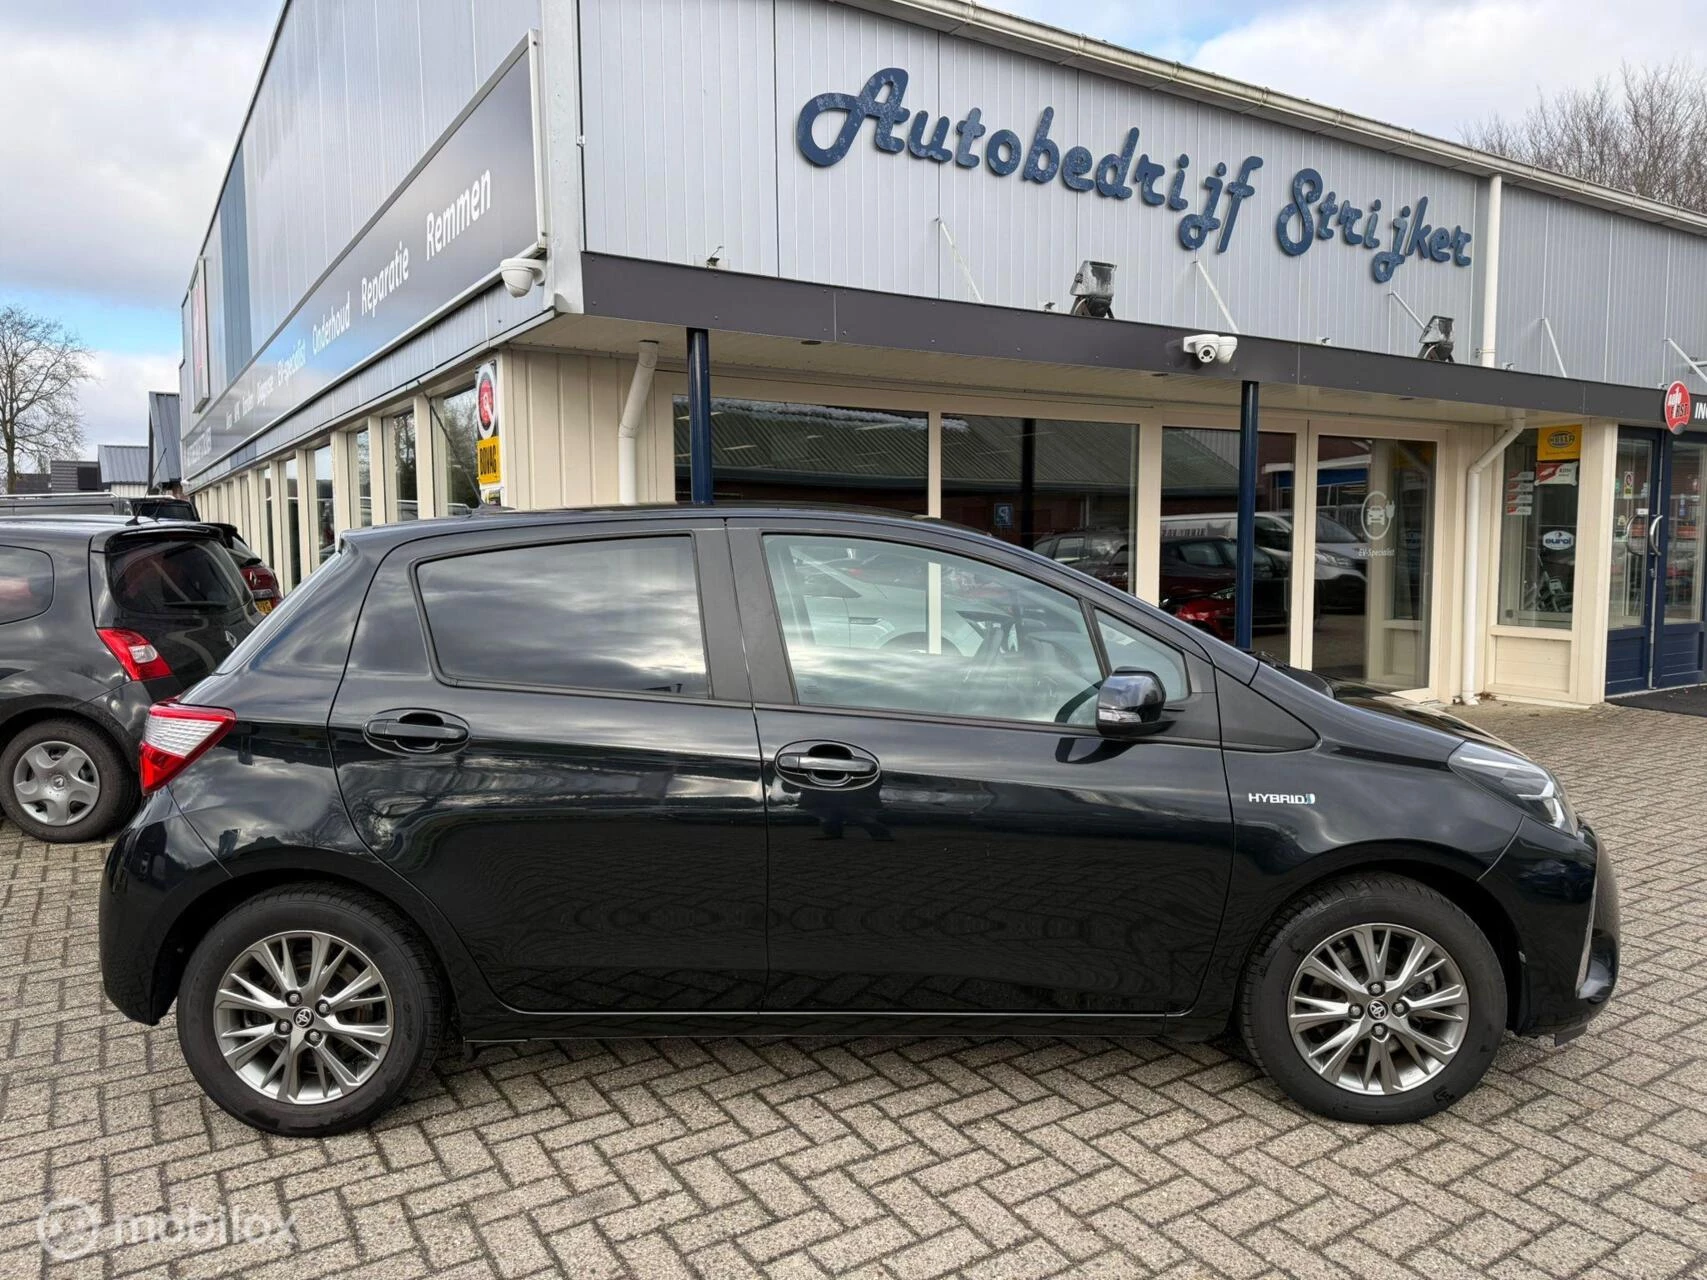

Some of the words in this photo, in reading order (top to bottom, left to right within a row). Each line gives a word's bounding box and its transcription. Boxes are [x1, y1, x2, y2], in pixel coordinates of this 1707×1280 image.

[797, 67, 1263, 254] Autobedrijf
[1276, 168, 1472, 283] Strijker
[311, 291, 351, 356] Onderhoud
[360, 241, 410, 318] Reparatie
[425, 168, 492, 261] Remmen
[1694, 401, 1707, 420] IN
[1545, 536, 1572, 545] eurol
[1248, 792, 1306, 805] HYBRID
